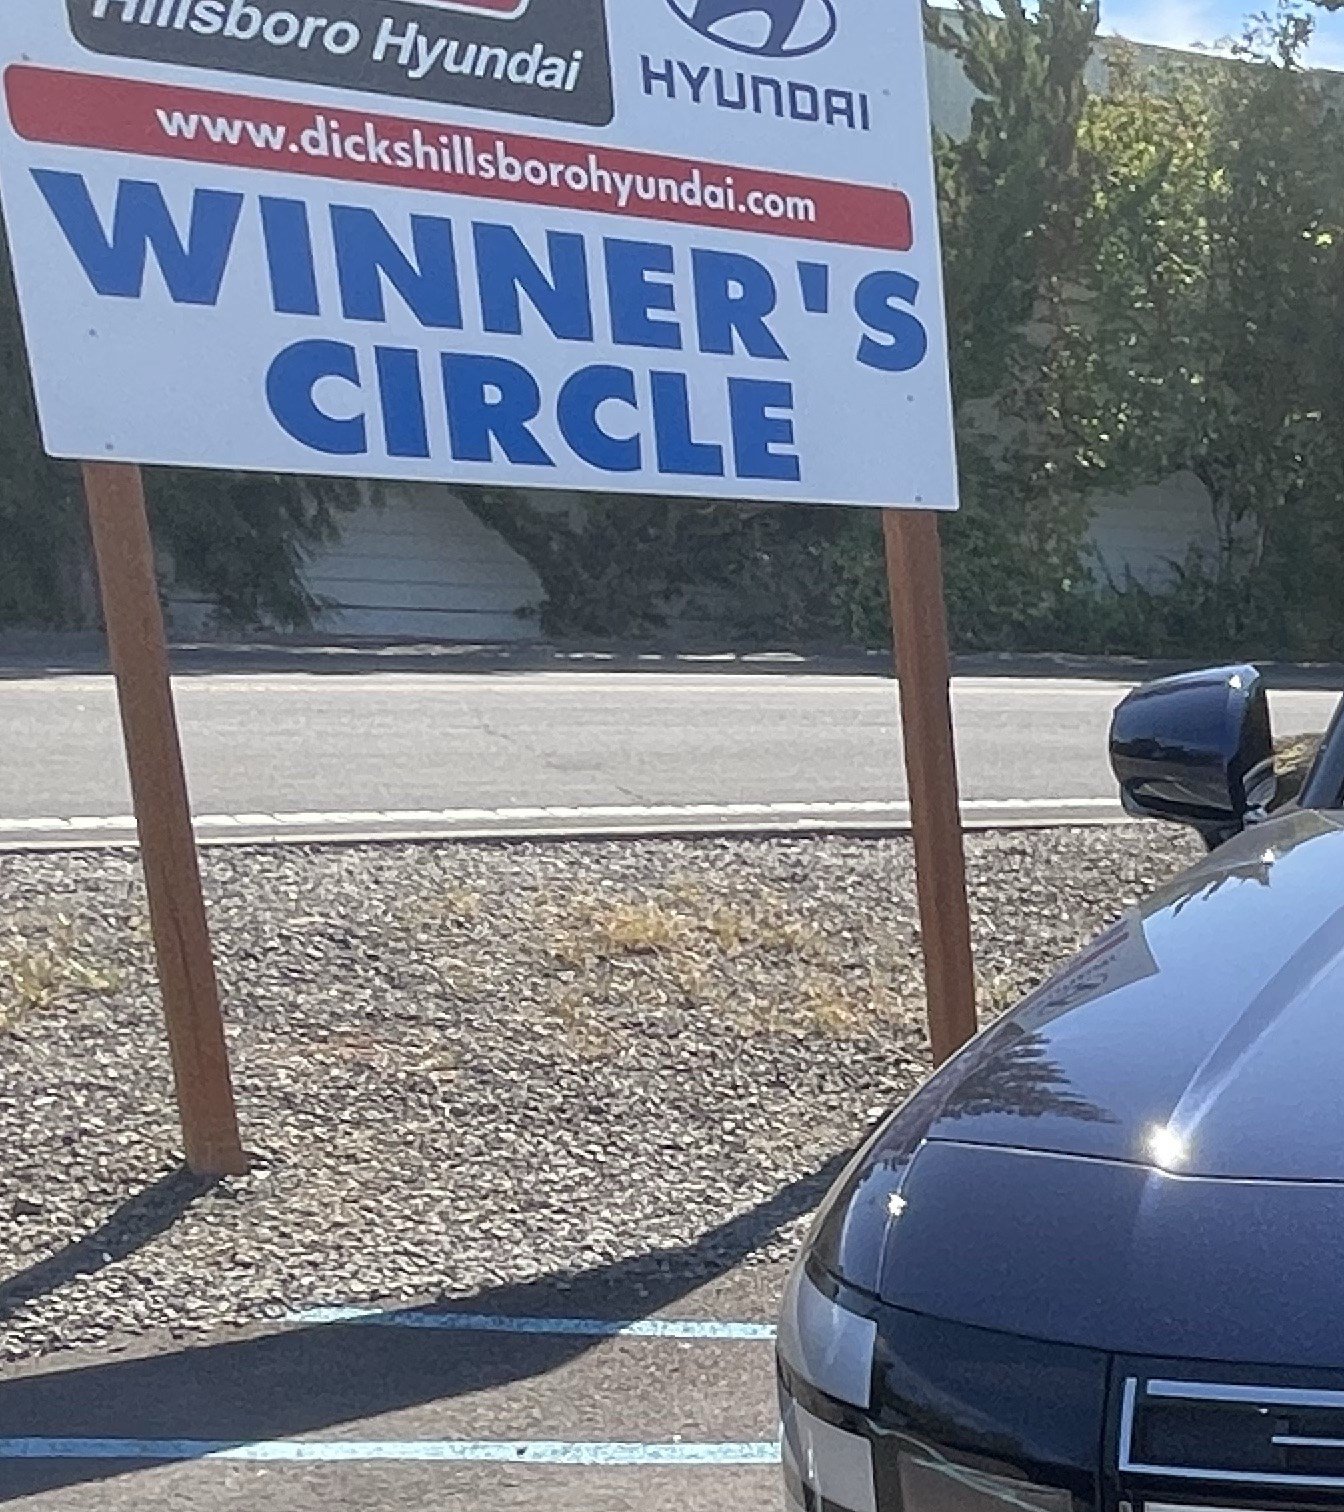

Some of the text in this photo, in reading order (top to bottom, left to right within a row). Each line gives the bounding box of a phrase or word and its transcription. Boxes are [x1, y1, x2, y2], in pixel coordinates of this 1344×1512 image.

[371, 18, 584, 92] Hyundai
[639, 55, 870, 130] HYUNDAI
[156, 106, 816, 223] www.dickshillsborohyundai.com
[28, 168, 929, 372] WINNER'S
[265, 339, 801, 481] CIRCLE
